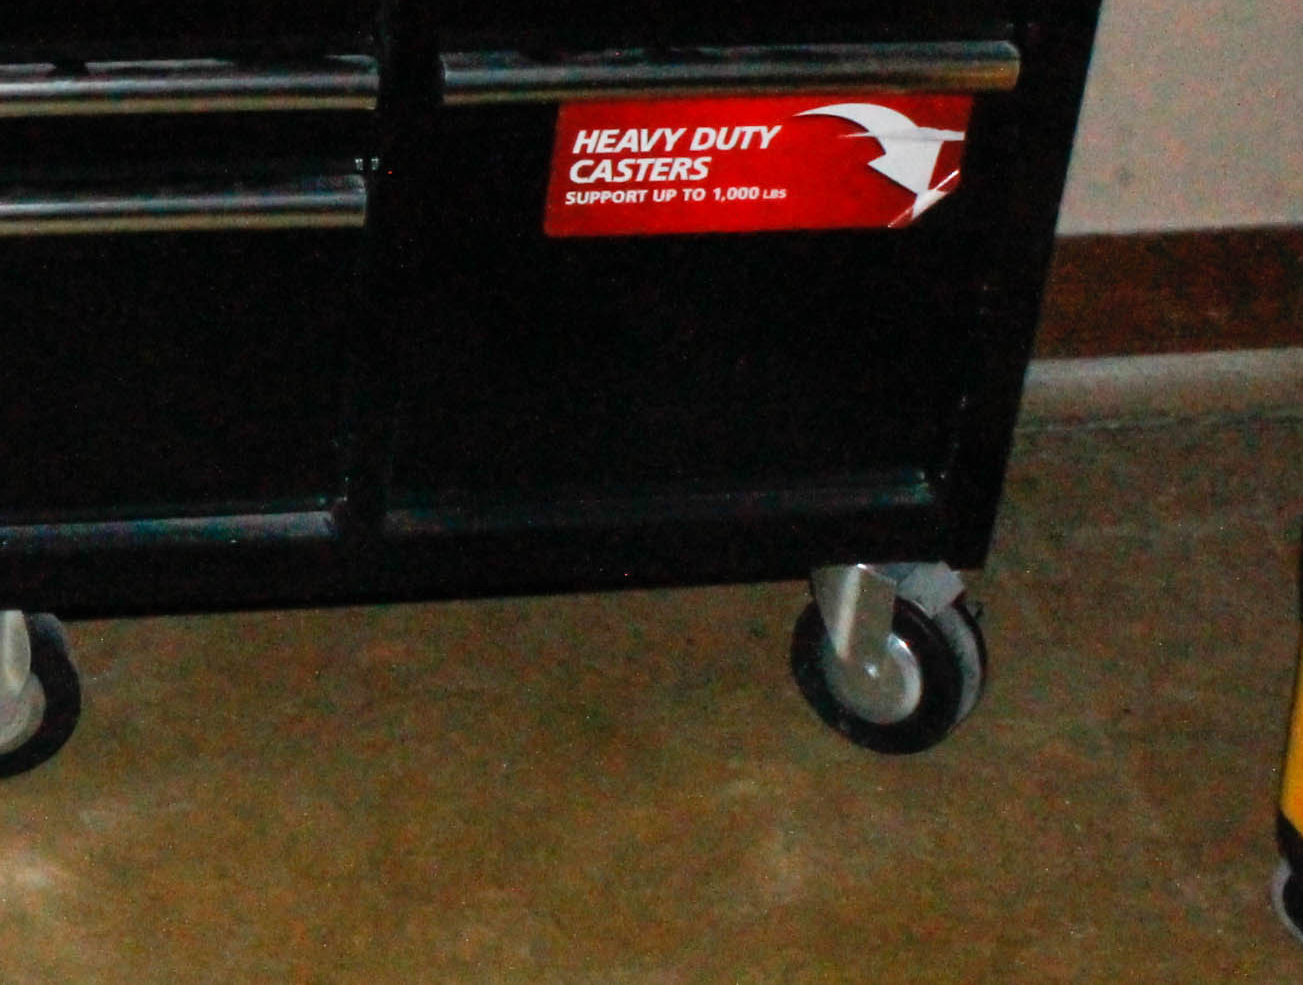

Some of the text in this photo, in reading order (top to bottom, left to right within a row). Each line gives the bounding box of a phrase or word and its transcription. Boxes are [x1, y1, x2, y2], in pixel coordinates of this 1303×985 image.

[572, 125, 783, 154] HEAVY DUTY
[568, 156, 712, 184] CASTERS
[564, 186, 788, 205] SUPPORT UP TO 1,000 LBS
